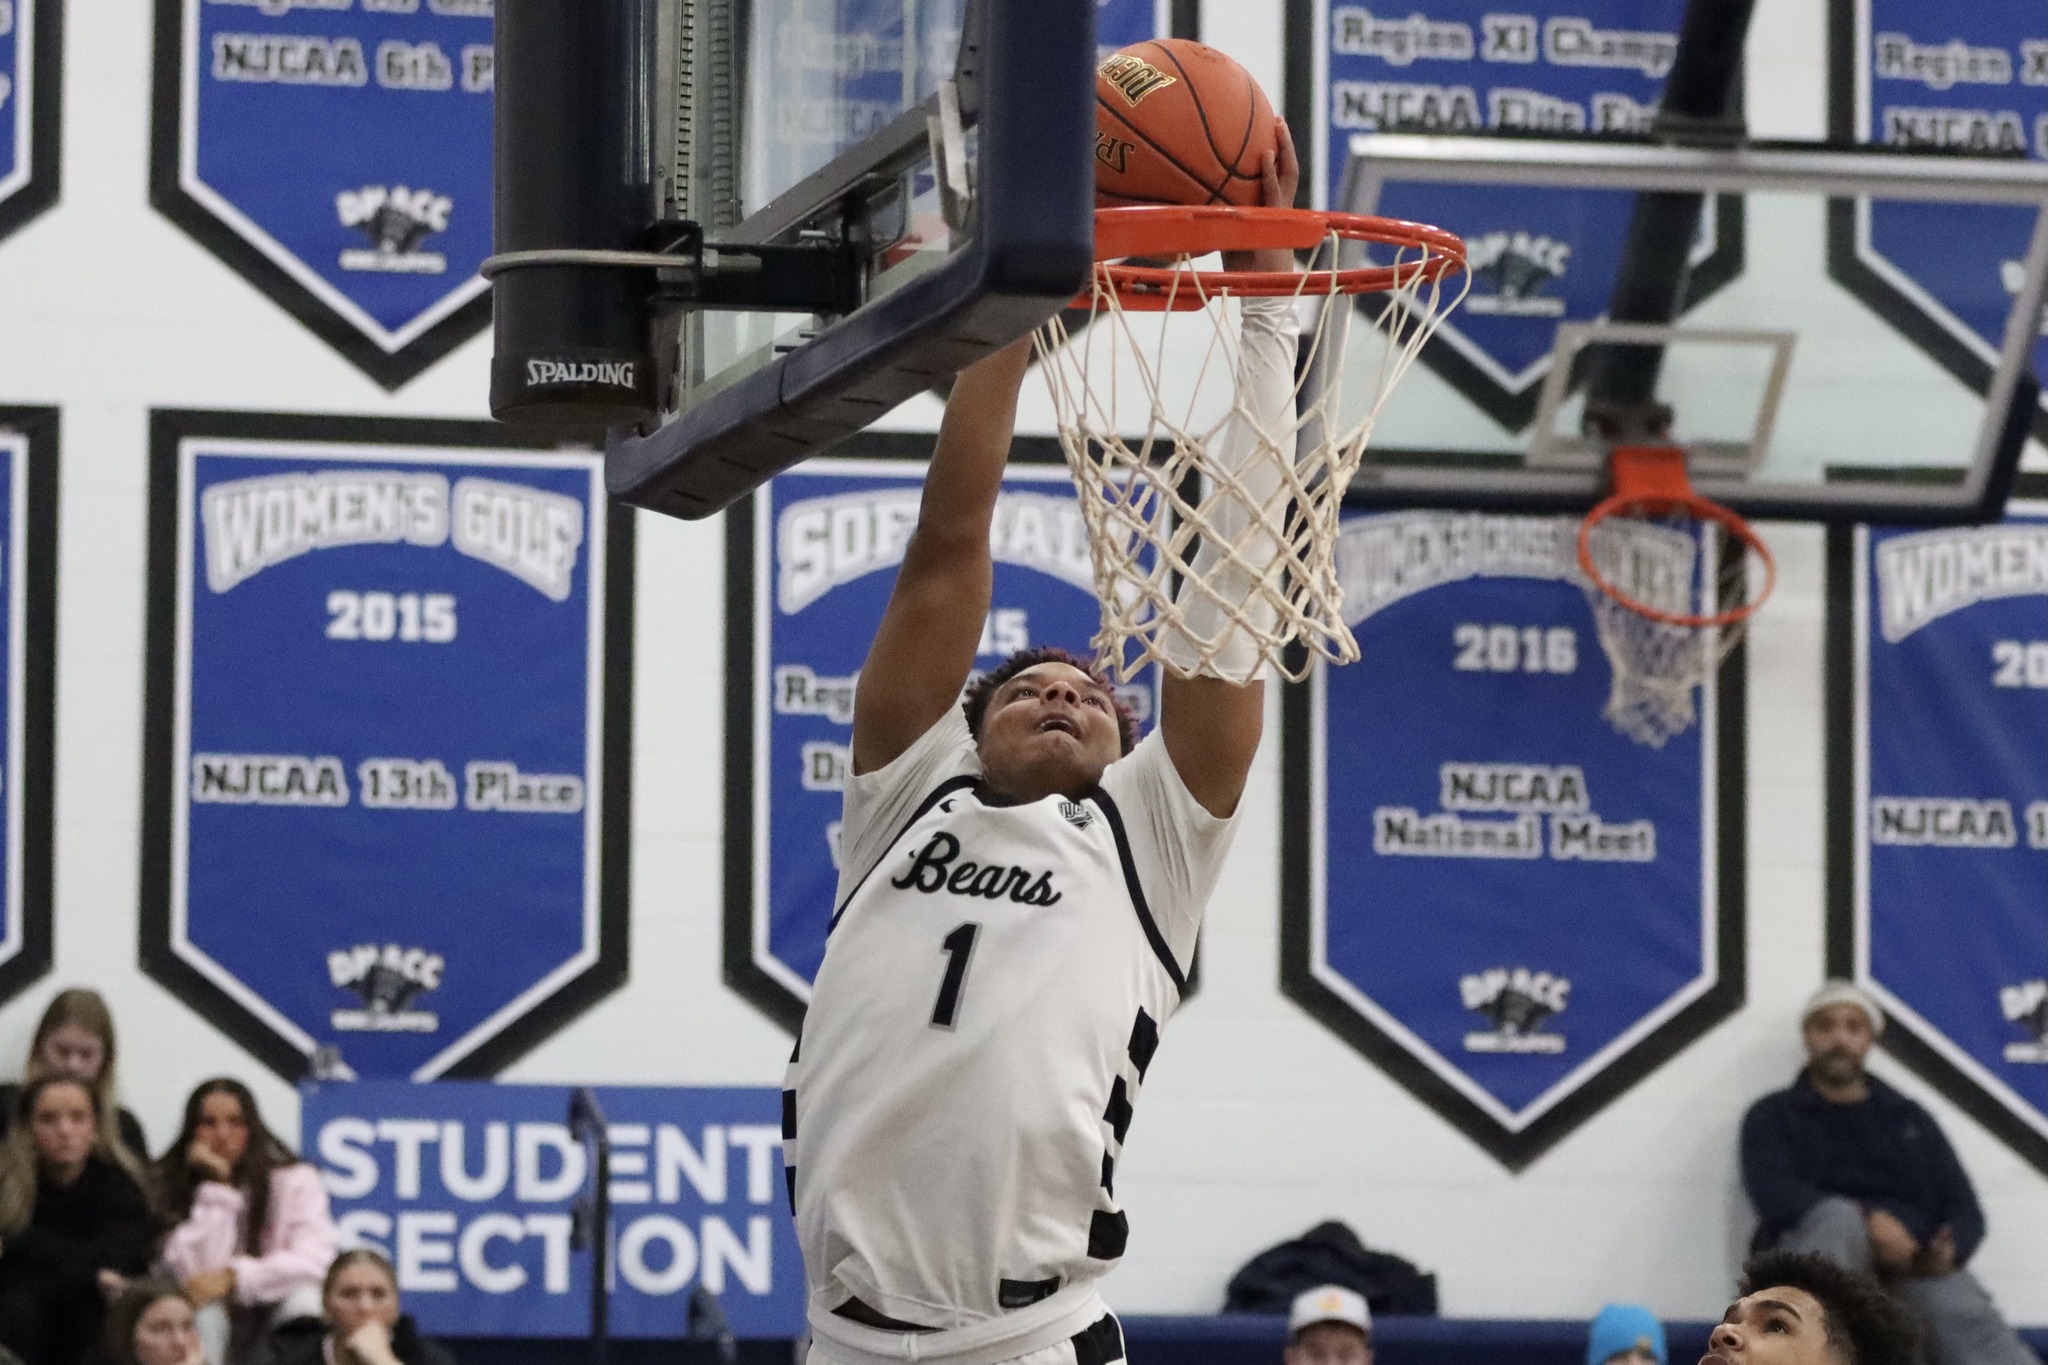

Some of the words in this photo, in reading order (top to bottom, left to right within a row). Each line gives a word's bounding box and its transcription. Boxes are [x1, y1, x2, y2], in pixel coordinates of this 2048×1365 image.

[212, 32, 367, 87] NJCAA
[1544, 17, 1680, 78] Champ
[1098, 54, 1177, 108] NJCA
[527, 359, 635, 388] SPALDING
[452, 476, 584, 602] GOLF
[777, 487, 1153, 622] SOFAL
[326, 591, 458, 642] 2015
[976, 607, 1030, 656] 15
[1454, 623, 1578, 674] 2016
[1993, 640, 2048, 688] 20
[775, 665, 855, 723] Reg
[193, 753, 349, 806] NJCAA
[358, 758, 458, 810] 13th
[463, 761, 585, 814] Place
[1439, 764, 1589, 814] NJCAA
[1374, 807, 1543, 860] National
[1550, 811, 1656, 862] Meet
[1872, 797, 2017, 848] NJCAA
[891, 831, 1062, 907] Bears
[929, 920, 983, 1032] 1
[318, 1117, 782, 1204] STUDENT
